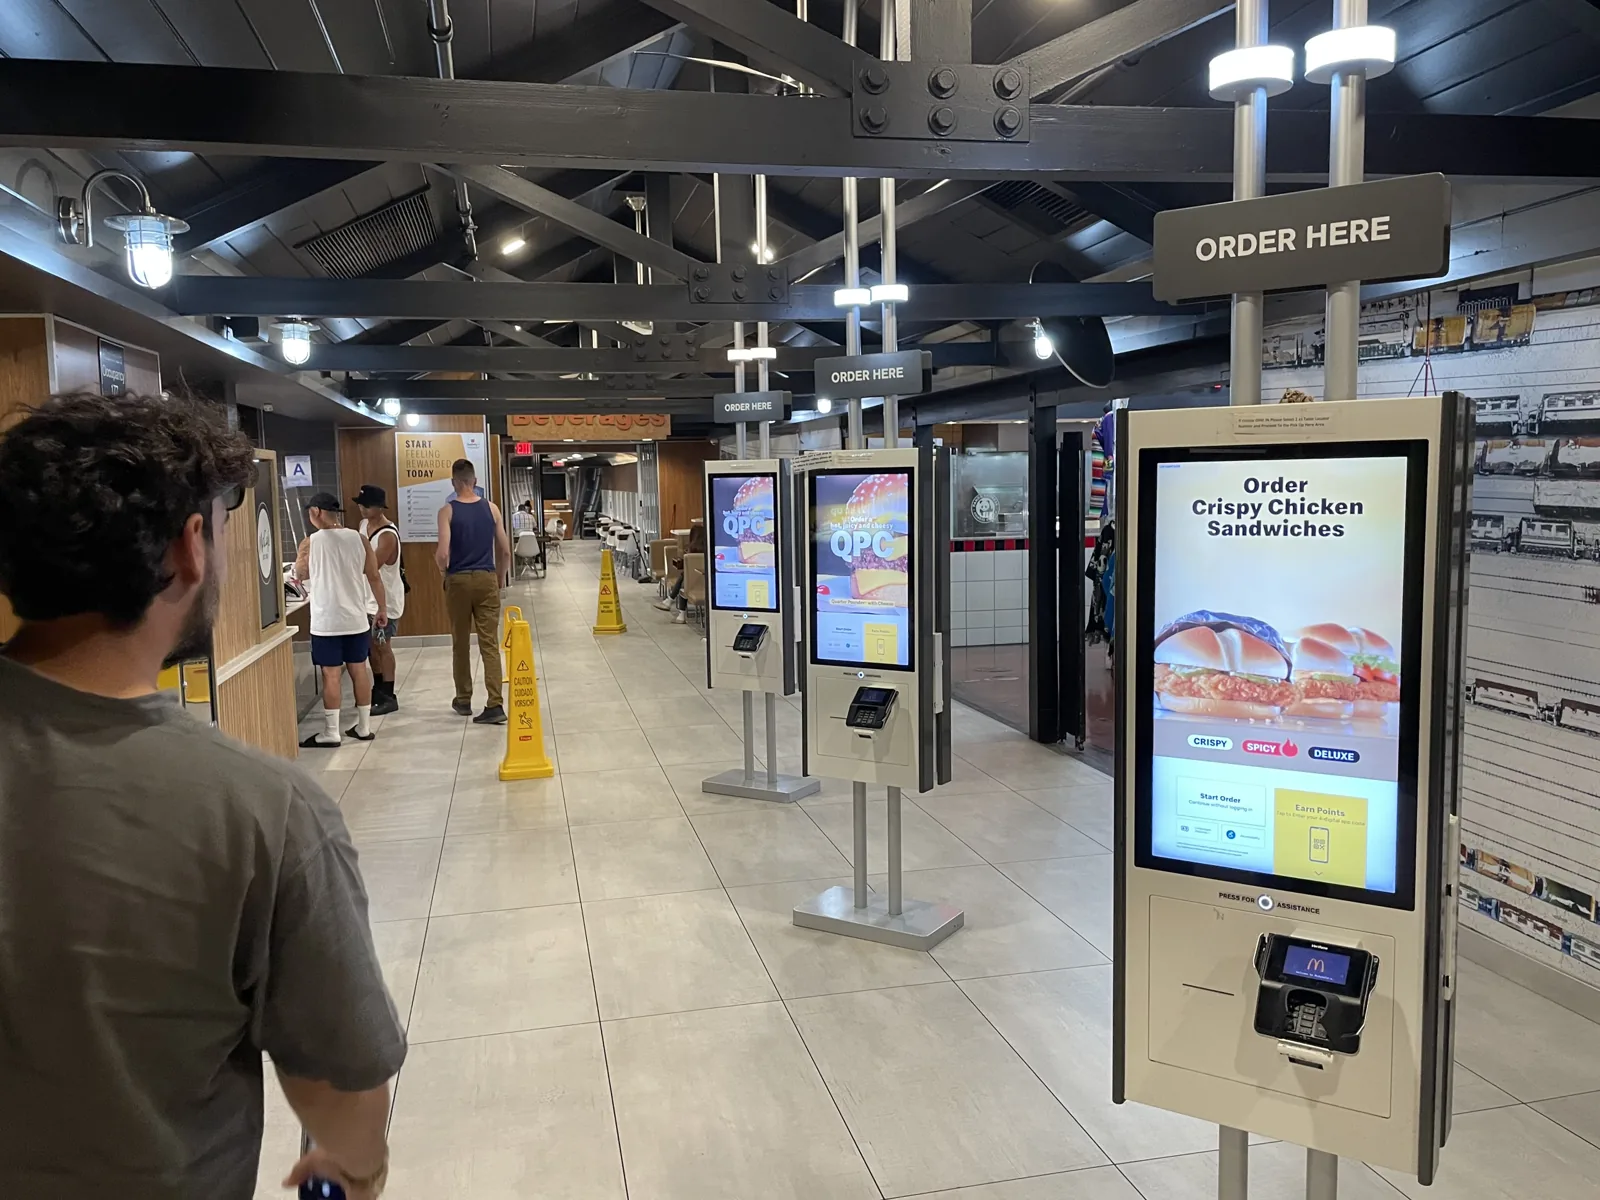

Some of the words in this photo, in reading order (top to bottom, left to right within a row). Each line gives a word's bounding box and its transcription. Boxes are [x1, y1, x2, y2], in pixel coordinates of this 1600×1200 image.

[1196, 228, 1296, 261] ORDER
[1306, 216, 1390, 248] HERE
[831, 369, 870, 383] ORDER
[873, 367, 904, 380] HERE
[724, 403, 750, 412] ORDER
[751, 402, 772, 410] HERE
[405, 440, 432, 448] START
[406, 450, 440, 458] FEELING
[293, 463, 305, 475] A
[406, 460, 452, 468] REWARDED
[406, 470, 434, 478] TODAY
[1243, 477, 1308, 493] Order
[1192, 497, 1262, 519] Crispy
[1268, 497, 1363, 514] Chicken
[723, 515, 765, 539] QPC
[1207, 519, 1344, 537] Sandwiches
[830, 531, 894, 562] QPC
[514, 677, 532, 685] CAUTION
[514, 688, 533, 697] CUIDADO
[1194, 737, 1227, 748] CRISPY
[1247, 742, 1276, 753] SPICY
[1314, 749, 1355, 761] DELUXE
[1200, 793, 1219, 801] Start
[1220, 795, 1241, 803] Order
[1295, 804, 1315, 813] Earn
[1317, 807, 1345, 817] Points
[1218, 892, 1240, 901] PRESS
[1277, 902, 1320, 914] ASSISTANCE
